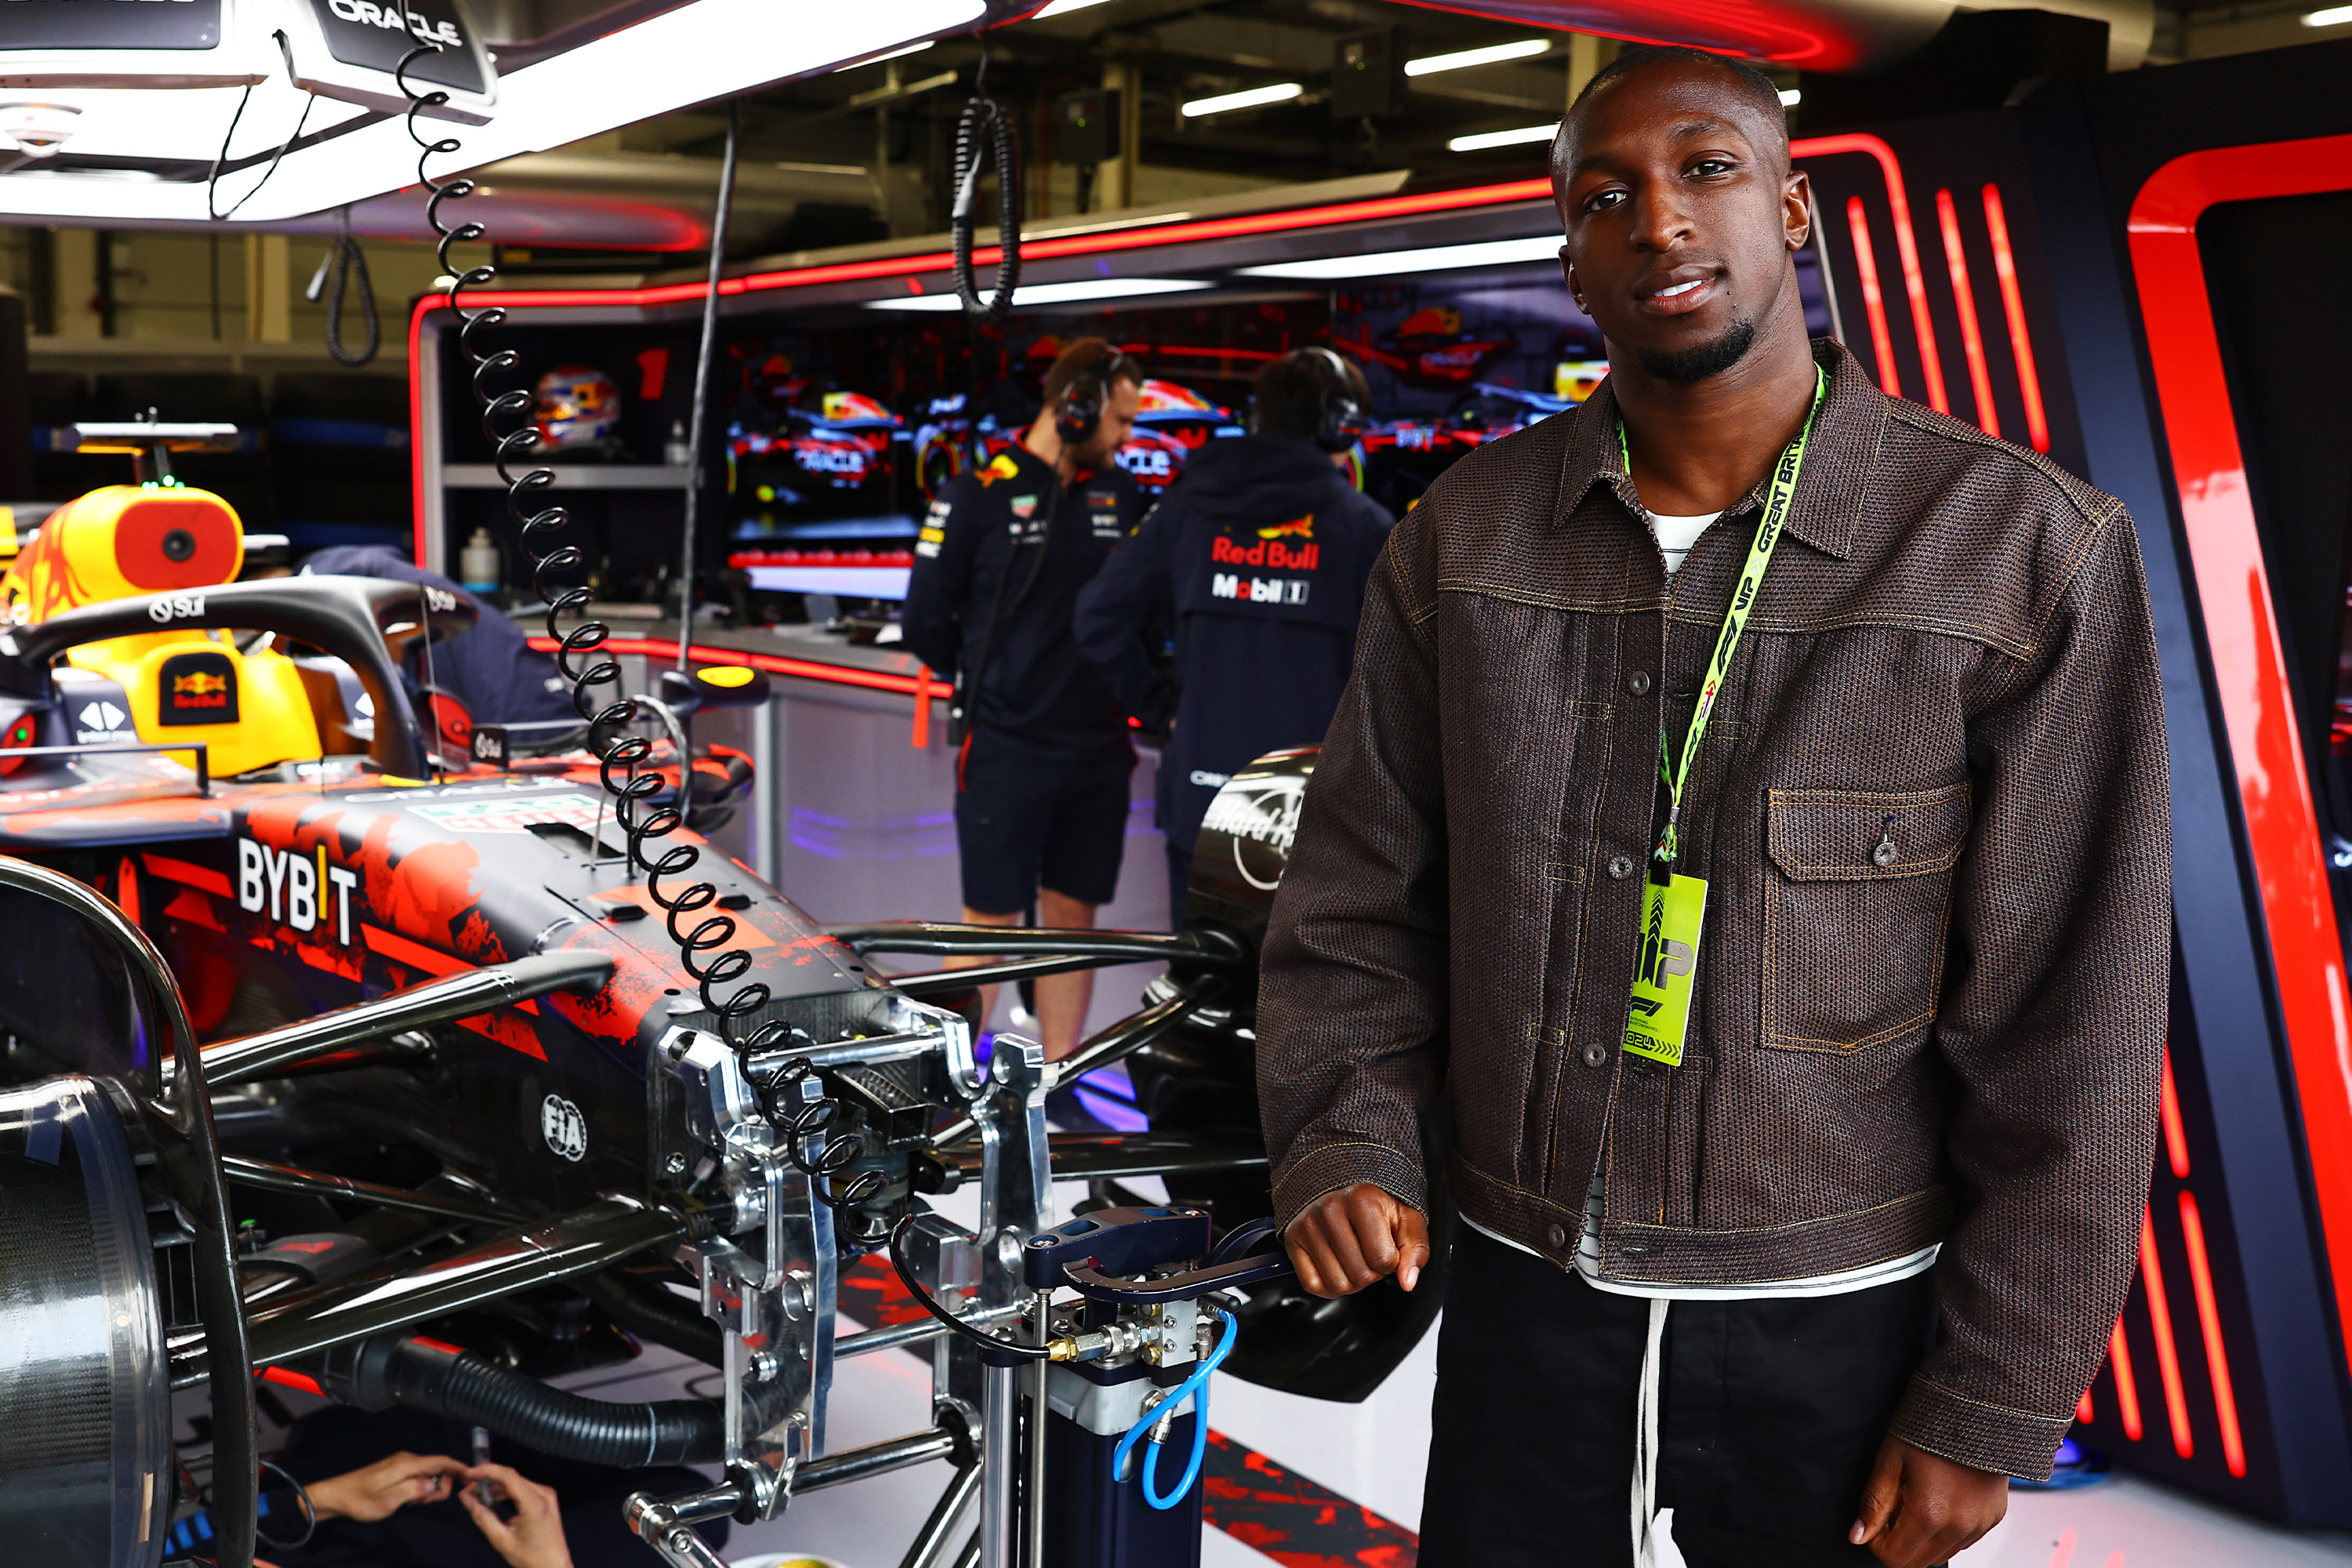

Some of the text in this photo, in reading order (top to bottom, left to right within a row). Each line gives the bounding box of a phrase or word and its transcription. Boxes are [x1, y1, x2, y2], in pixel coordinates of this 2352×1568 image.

[328, 0, 463, 47] ORACLE
[1757, 485, 1788, 554] GREAT
[1212, 535, 1319, 571] Red Bull
[1211, 572, 1283, 604] Mobil
[1734, 576, 1753, 611] VIP
[238, 837, 357, 946] BYBIT
[1624, 1030, 1657, 1051] 024
